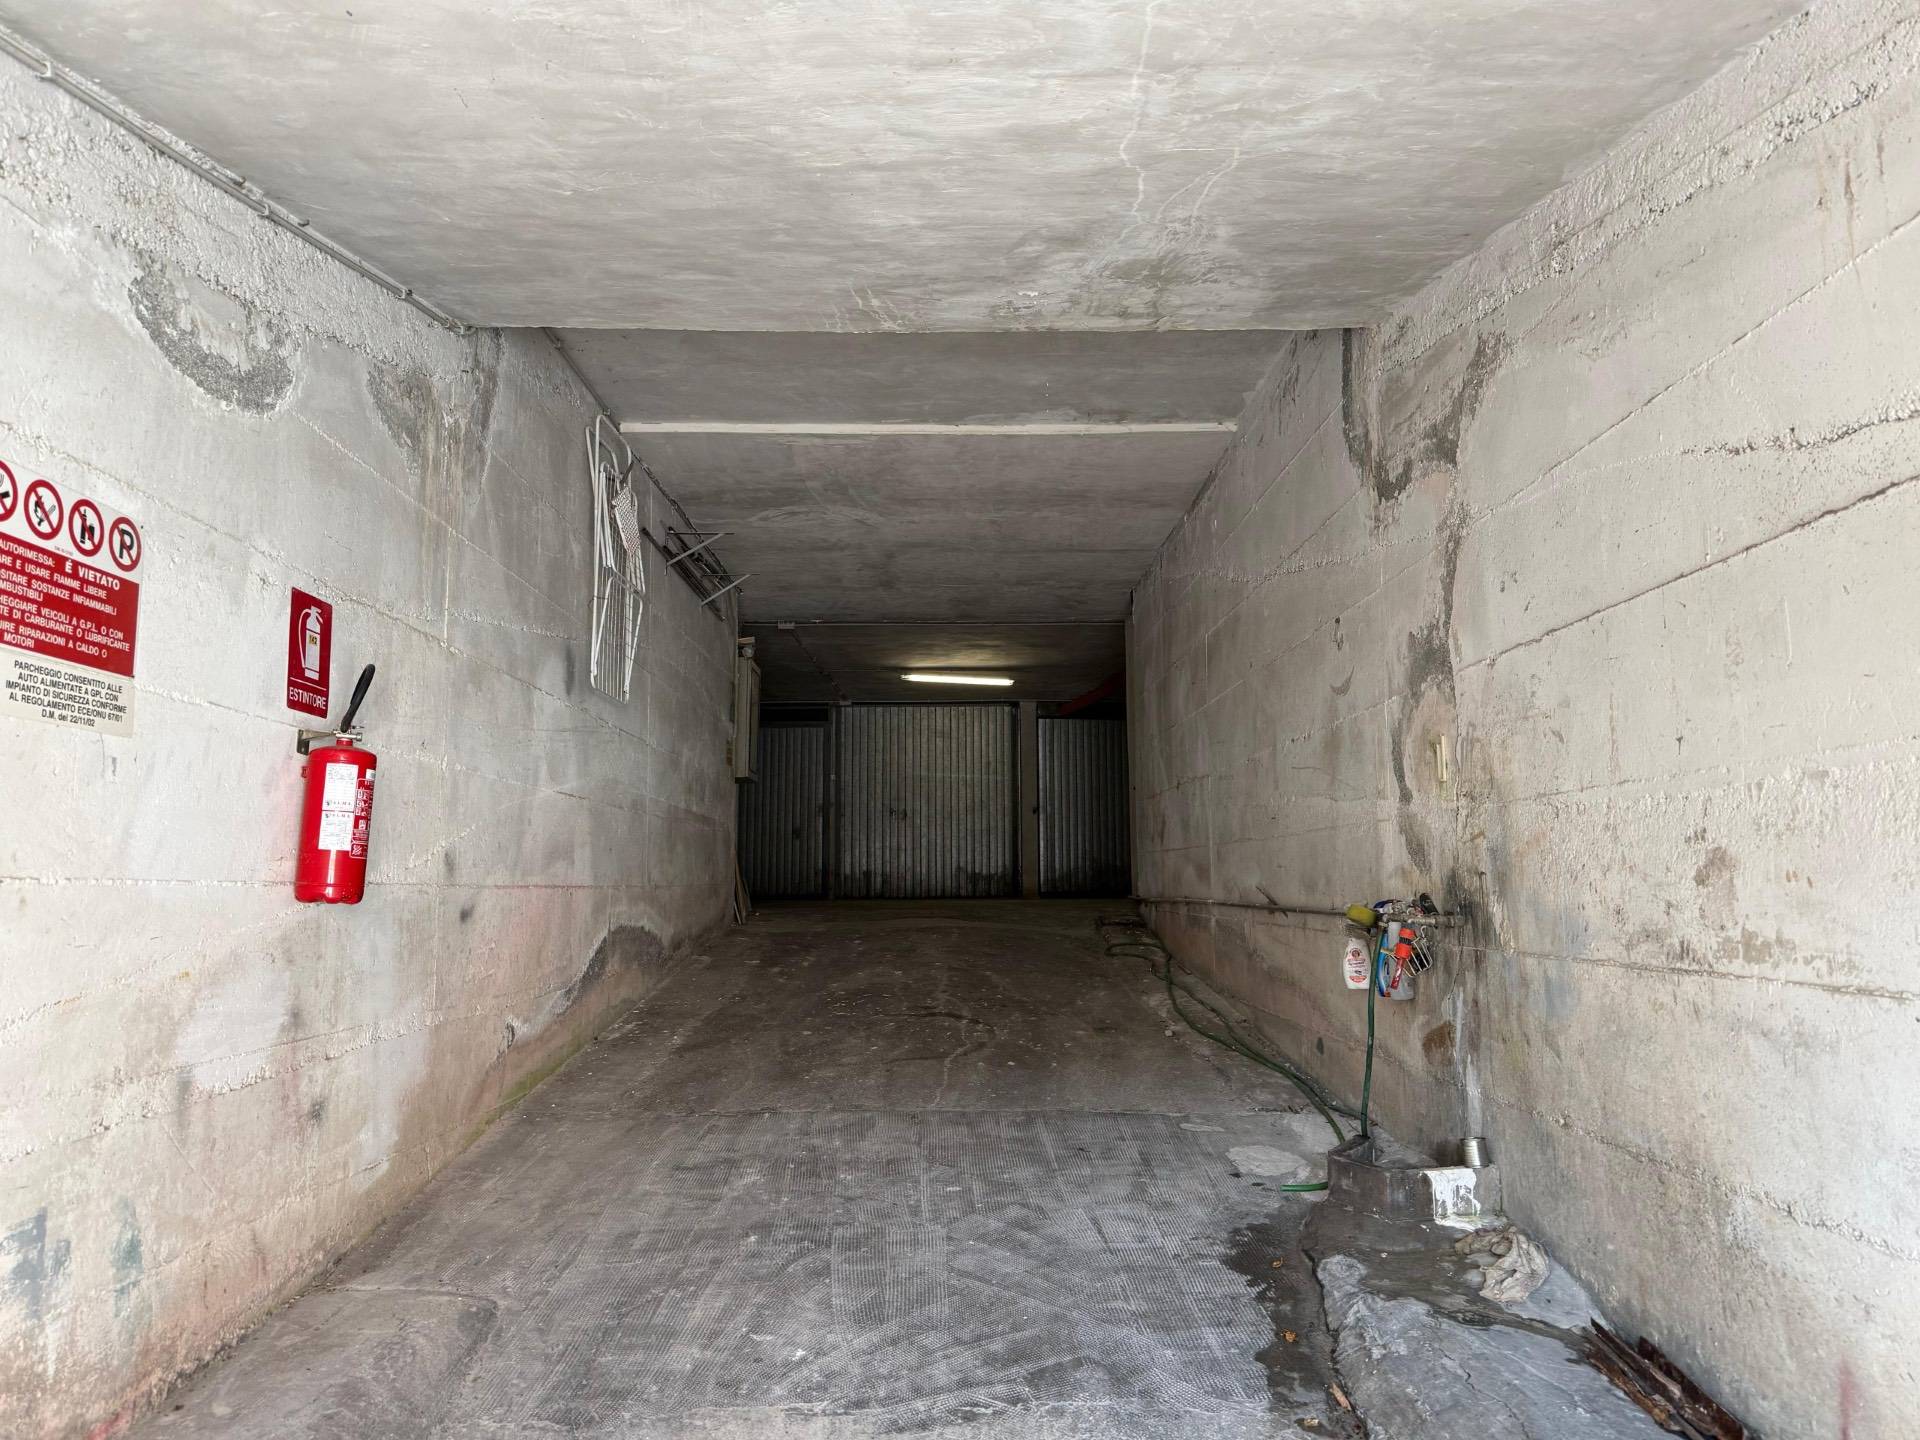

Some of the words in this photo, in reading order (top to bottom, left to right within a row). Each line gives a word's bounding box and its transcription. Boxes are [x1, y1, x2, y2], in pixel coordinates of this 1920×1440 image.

[15, 559, 22, 570] E
[25, 562, 51, 580] USARE
[53, 572, 81, 590] FIAMME
[83, 583, 107, 600] LIBERE
[78, 565, 120, 591] VIETATO
[31, 579, 70, 600] SOSTANZE
[72, 593, 117, 616] INFIAMMABILI
[3, 631, 35, 649] MOTORI
[12, 609, 21, 620] DI
[24, 612, 74, 635] CARBURANTE
[76, 628, 83, 639] O
[84, 630, 130, 653] LUBRIFICANTE
[40, 606, 70, 624] VEICOLI
[71, 617, 77, 627] A
[100, 625, 107, 636] O
[109, 628, 124, 641] CON
[19, 625, 66, 647] RIPARAZIONI
[67, 639, 74, 650] A
[75, 641, 100, 657] CALDO
[101, 649, 108, 659] O
[14, 659, 62, 681] PARCHEGGIO
[63, 671, 106, 691] CONSENTITO
[106, 683, 123, 695] ALLE
[18, 671, 39, 685] AUTO
[40, 677, 83, 696] ALIMENTATE
[84, 688, 89, 696] A
[90, 688, 104, 699] GPL
[104, 692, 119, 703] CON
[5, 679, 42, 696] IMPIANTO
[43, 688, 51, 698] DI
[52, 690, 90, 707] SICUREZZA
[91, 699, 128, 715] CONFORME
[9, 691, 19, 702] AL
[21, 694, 76, 713] REGOLAMENTO
[41, 708, 56, 720] D.M.
[288, 686, 327, 710] ESTINTORE
